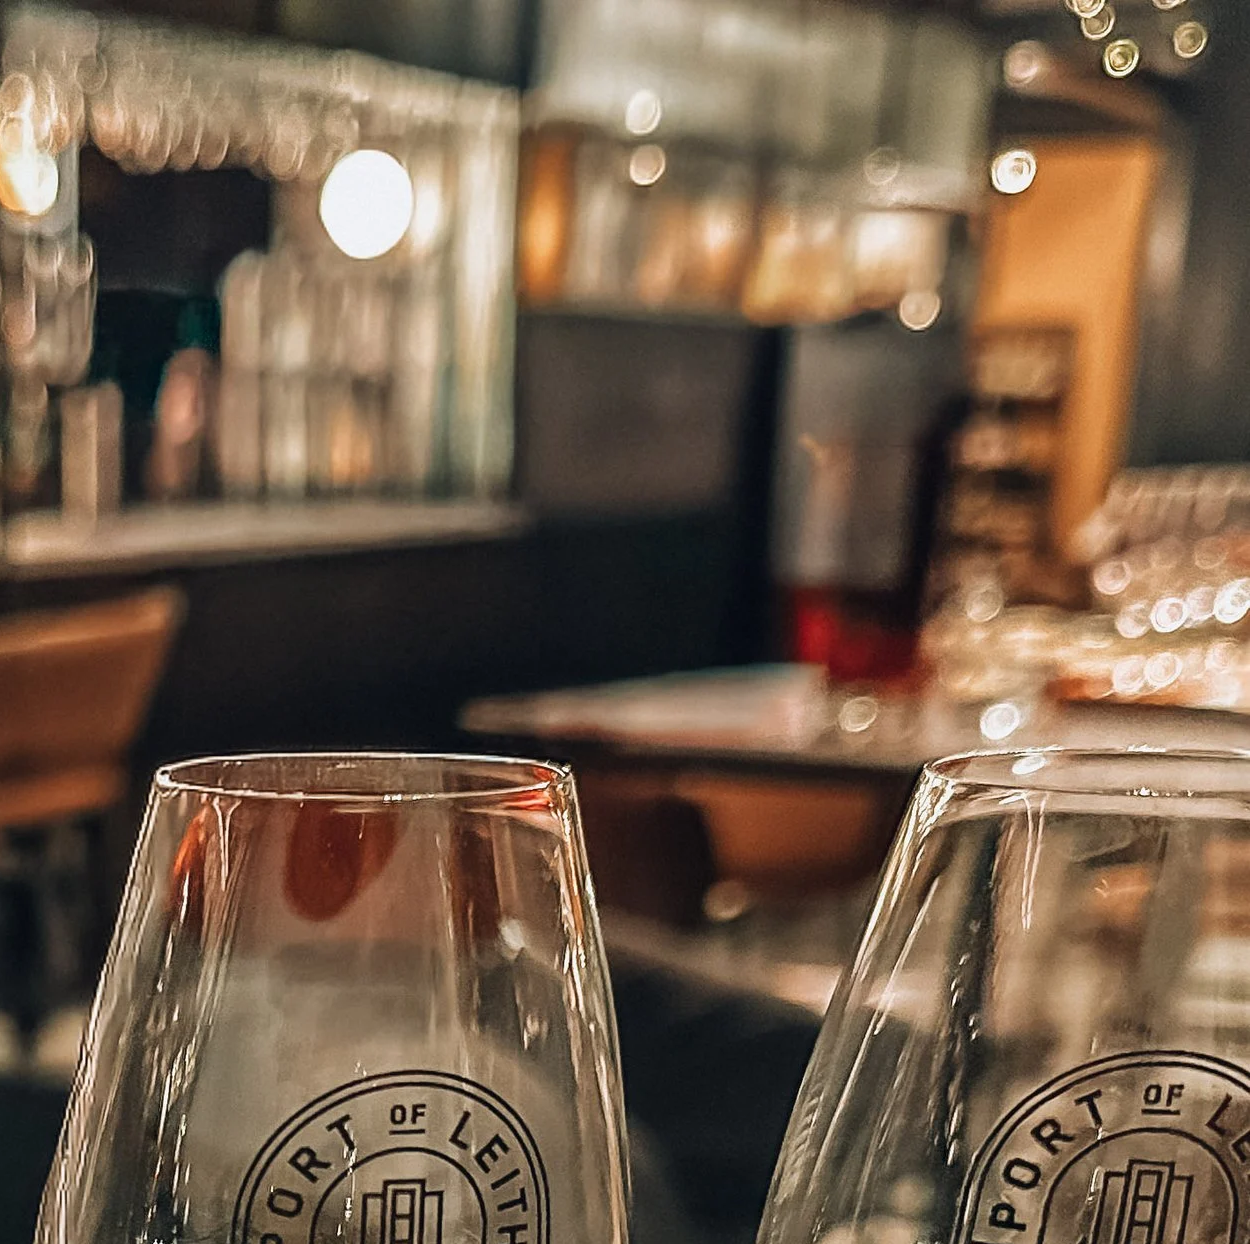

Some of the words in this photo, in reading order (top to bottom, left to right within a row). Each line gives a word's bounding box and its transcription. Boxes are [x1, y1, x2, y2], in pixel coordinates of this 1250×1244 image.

[390, 1103, 427, 1126] OF
[989, 1089, 1103, 1231] PORT
[1143, 1083, 1185, 1107] OF
